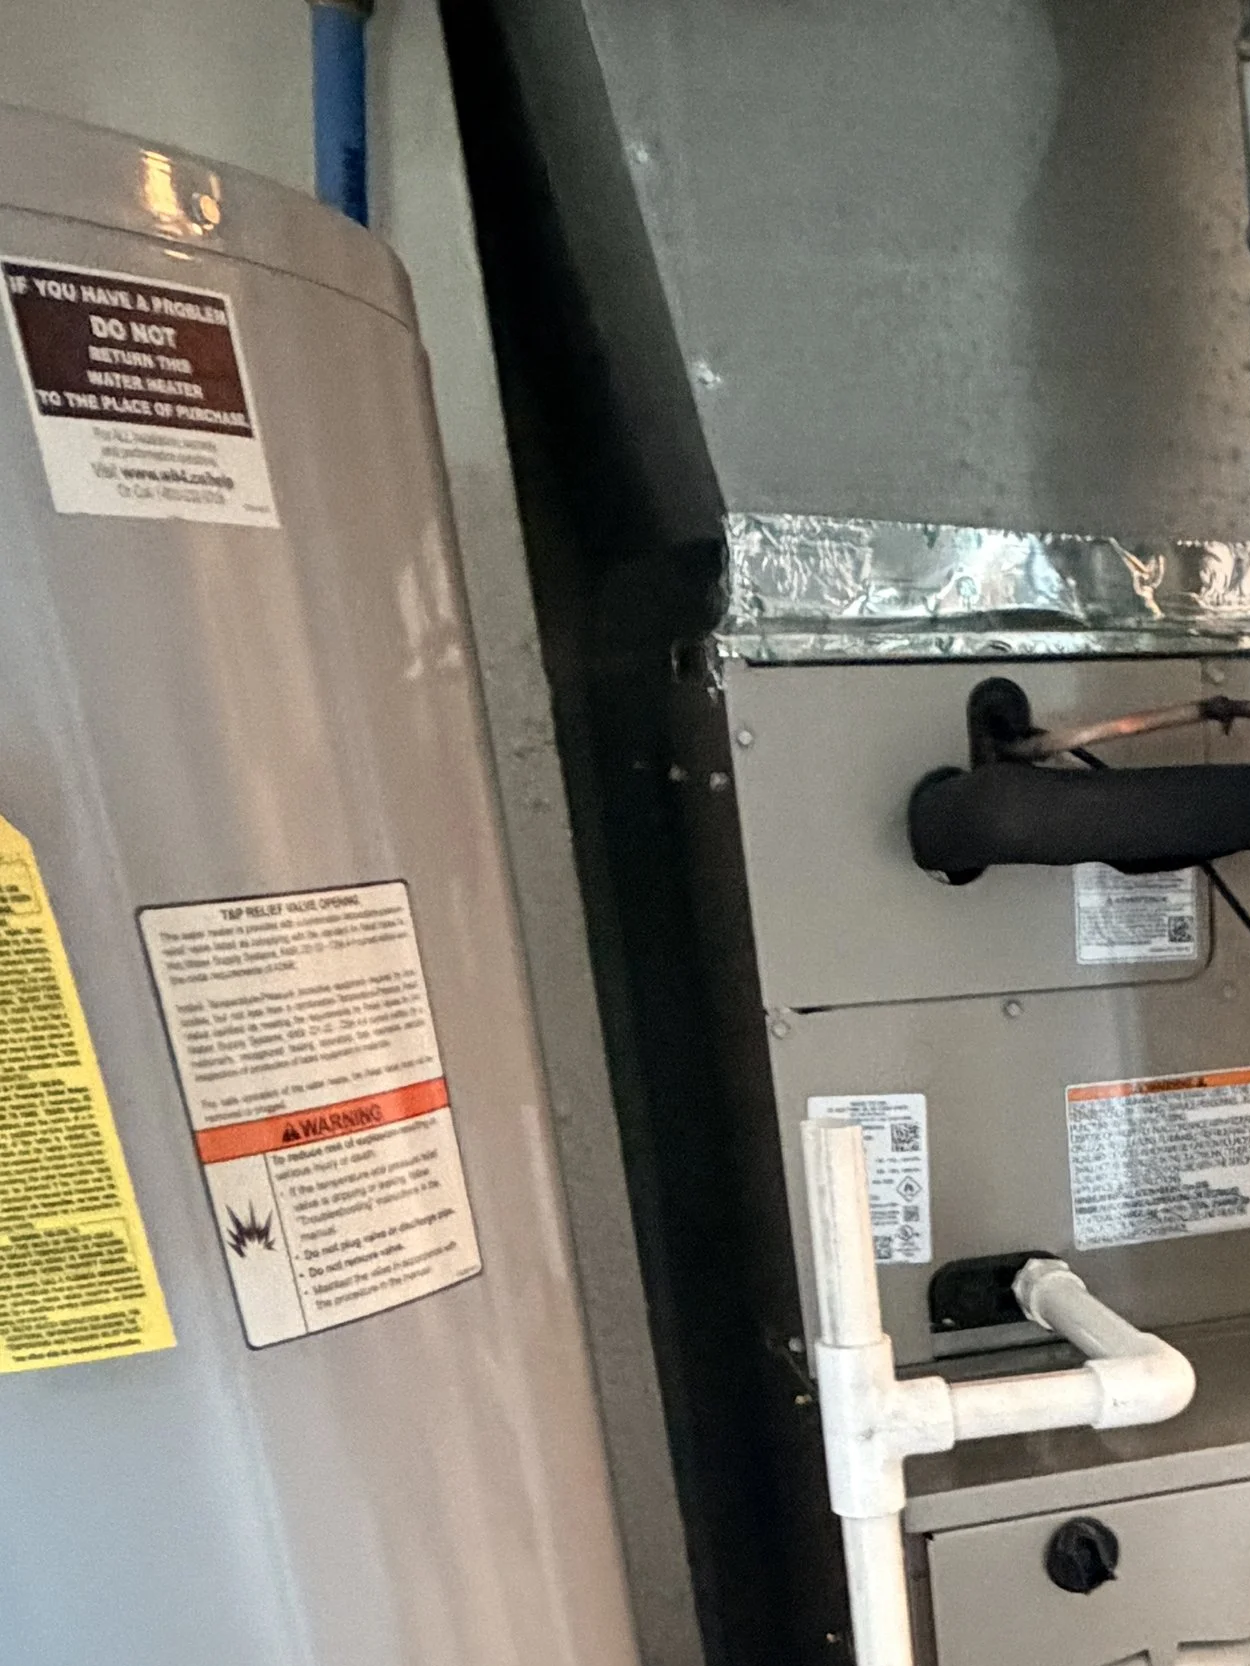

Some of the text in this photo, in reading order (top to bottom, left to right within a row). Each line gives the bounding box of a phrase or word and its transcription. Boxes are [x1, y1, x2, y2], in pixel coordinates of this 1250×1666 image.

[9, 276, 28, 293] IF
[33, 278, 75, 300] YOU
[80, 285, 131, 309] HAVE
[135, 297, 150, 311] A
[90, 316, 178, 347] DO NOT
[89, 346, 191, 373] RETURN THIS
[87, 371, 202, 397] WATER HEATER
[38, 389, 61, 404] TO
[65, 391, 98, 408] THE
[102, 397, 150, 414] PLACE
[153, 403, 173, 416] OF
[301, 1105, 381, 1135] WARNING
